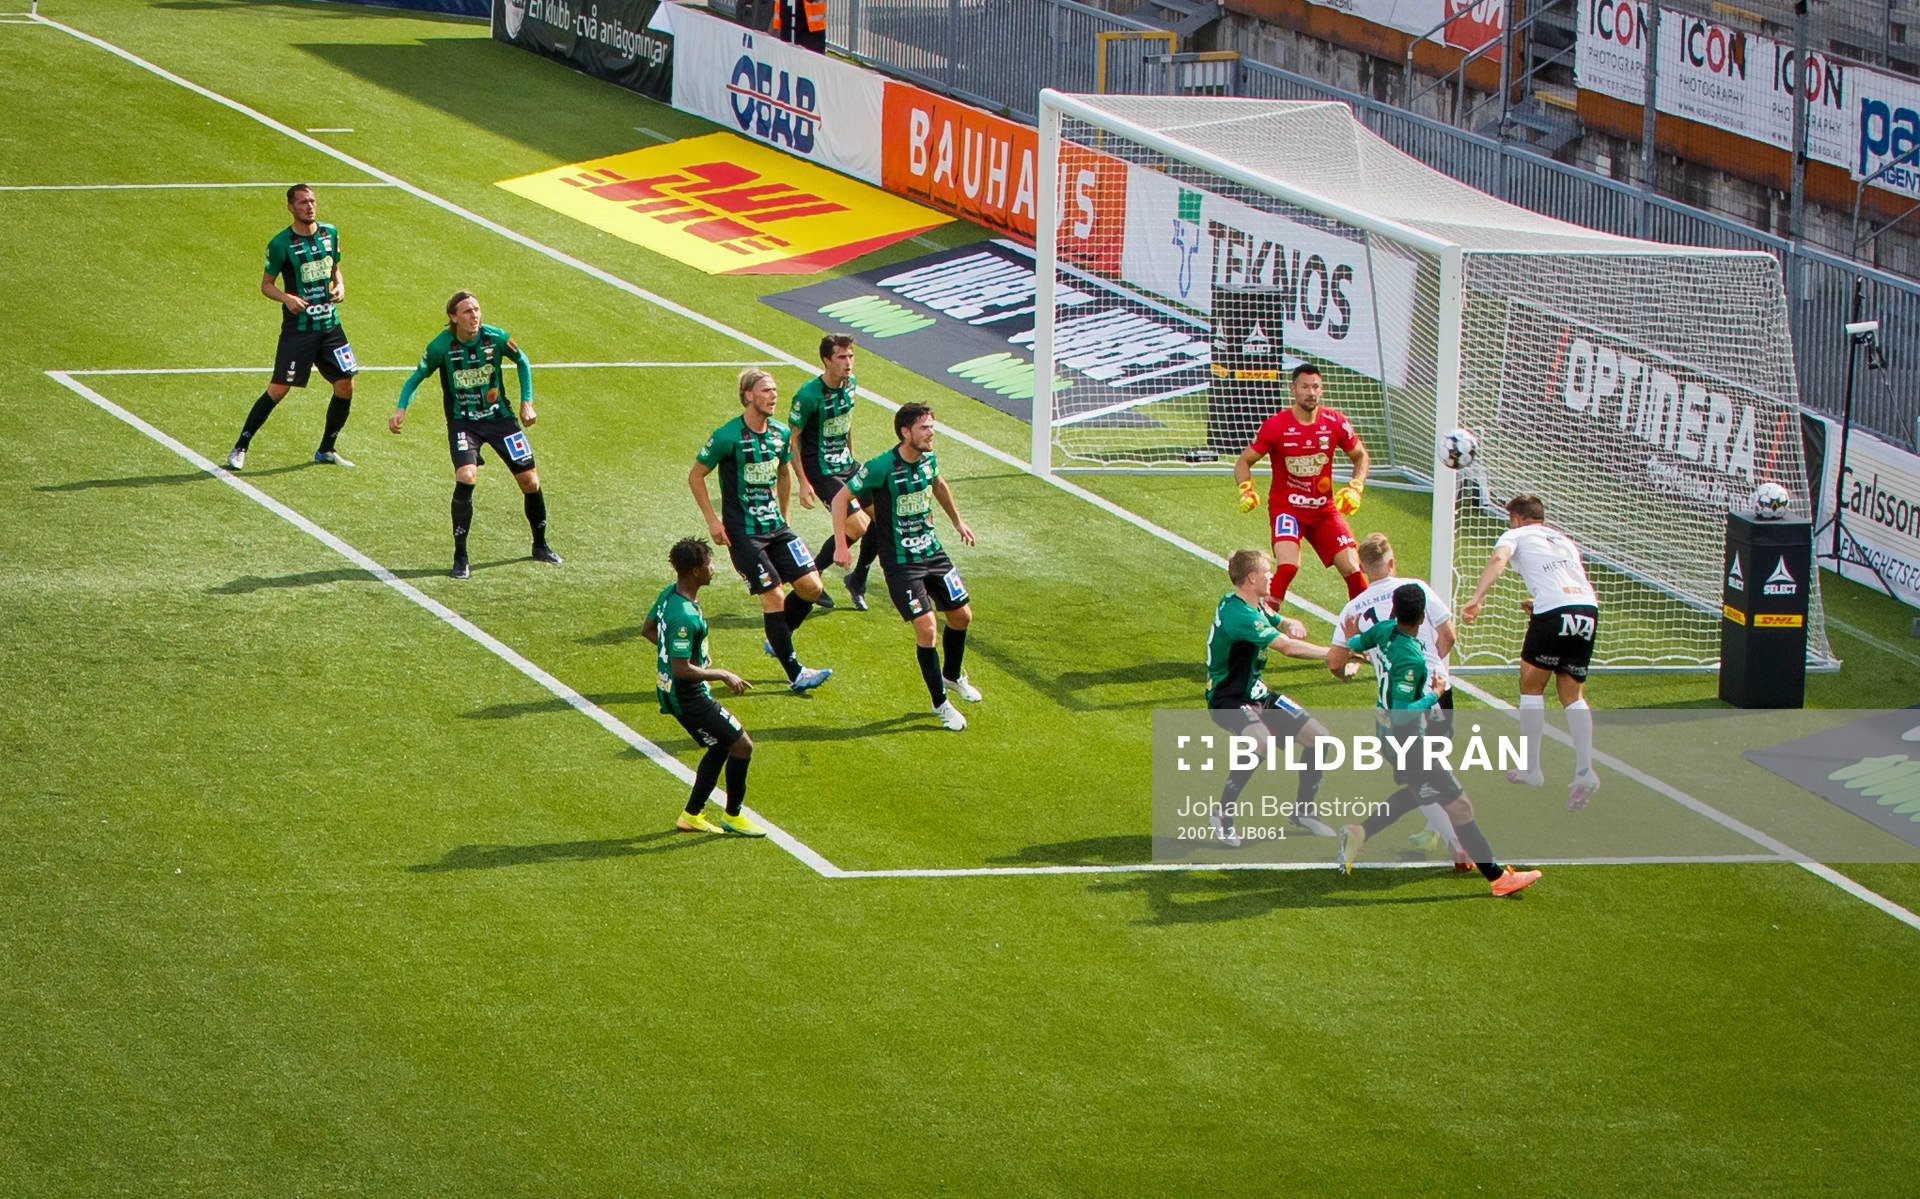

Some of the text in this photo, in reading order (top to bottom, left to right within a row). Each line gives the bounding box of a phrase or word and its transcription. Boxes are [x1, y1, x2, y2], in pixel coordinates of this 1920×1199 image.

[545, 0, 571, 31] klubb
[1680, 15, 1748, 81] ICON
[1207, 218, 1354, 341] TEKNOS
[1563, 337, 1756, 484] OPTIMERA
[906, 590, 913, 600] 7
[1763, 583, 1796, 595] SELECT
[1558, 613, 1596, 641] NA
